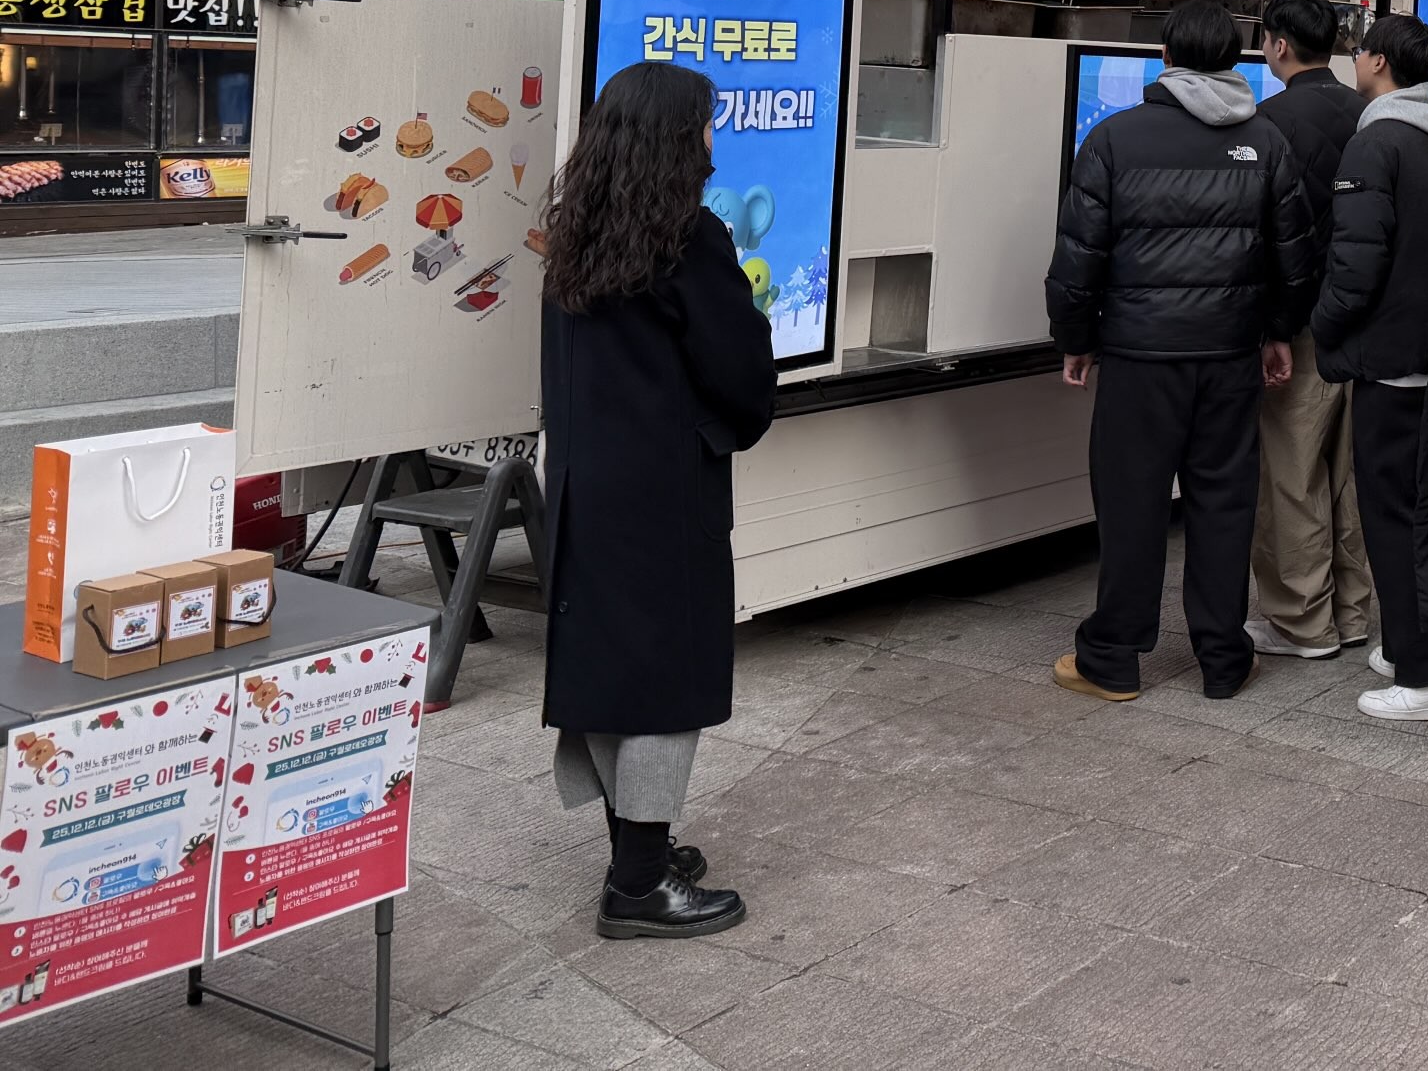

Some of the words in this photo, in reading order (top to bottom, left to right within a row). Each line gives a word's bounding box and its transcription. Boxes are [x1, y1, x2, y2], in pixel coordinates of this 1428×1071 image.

[643, 17, 706, 61] 간식
[712, 20, 797, 61] 무료로
[714, 90, 814, 131] 가세요!!
[167, 167, 210, 184] Kelly
[253, 495, 281, 511] HON
[294, 691, 352, 714] 인천노동권익센터
[353, 688, 362, 698] 와
[364, 679, 399, 695] 함께하는
[267, 729, 305, 753] SNS
[310, 714, 357, 742] 팔로우
[362, 699, 407, 726] 이벤트
[74, 746, 143, 774] 인천노동권익센터
[144, 743, 155, 755] 와
[158, 733, 198, 751] 함께하는
[328, 734, 384, 757] 구월로데오광장
[44, 791, 88, 818] SNS
[94, 773, 150, 804] 팔로우
[156, 756, 209, 786] 이벤트
[305, 788, 347, 806] incheon914
[117, 795, 181, 821] 구월로데오광장
[88, 854, 137, 874] incheon914
